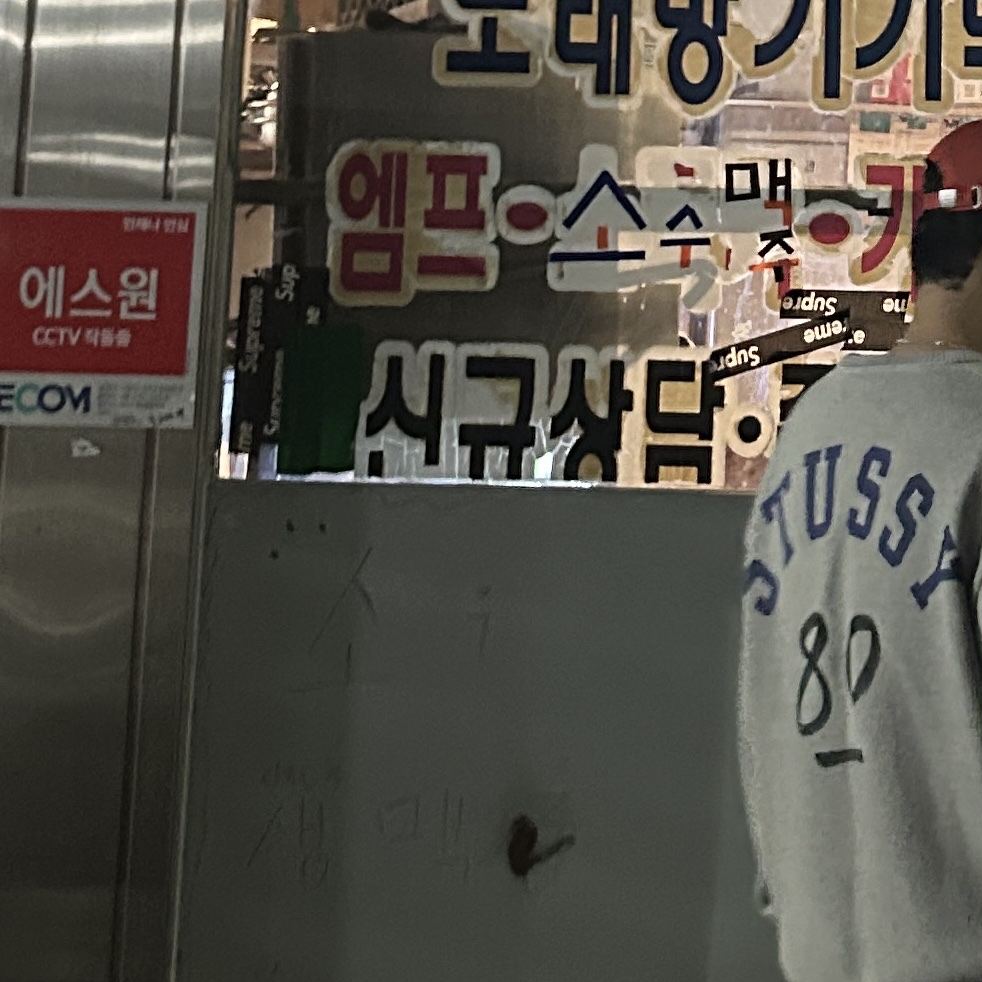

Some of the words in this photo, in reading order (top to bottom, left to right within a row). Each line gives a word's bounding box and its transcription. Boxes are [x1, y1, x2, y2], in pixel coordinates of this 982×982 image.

[19, 265, 159, 321] 에스원
[32, 326, 81, 347] CCTV
[745, 444, 961, 616] STUSSY
[796, 612, 881, 736] 80
